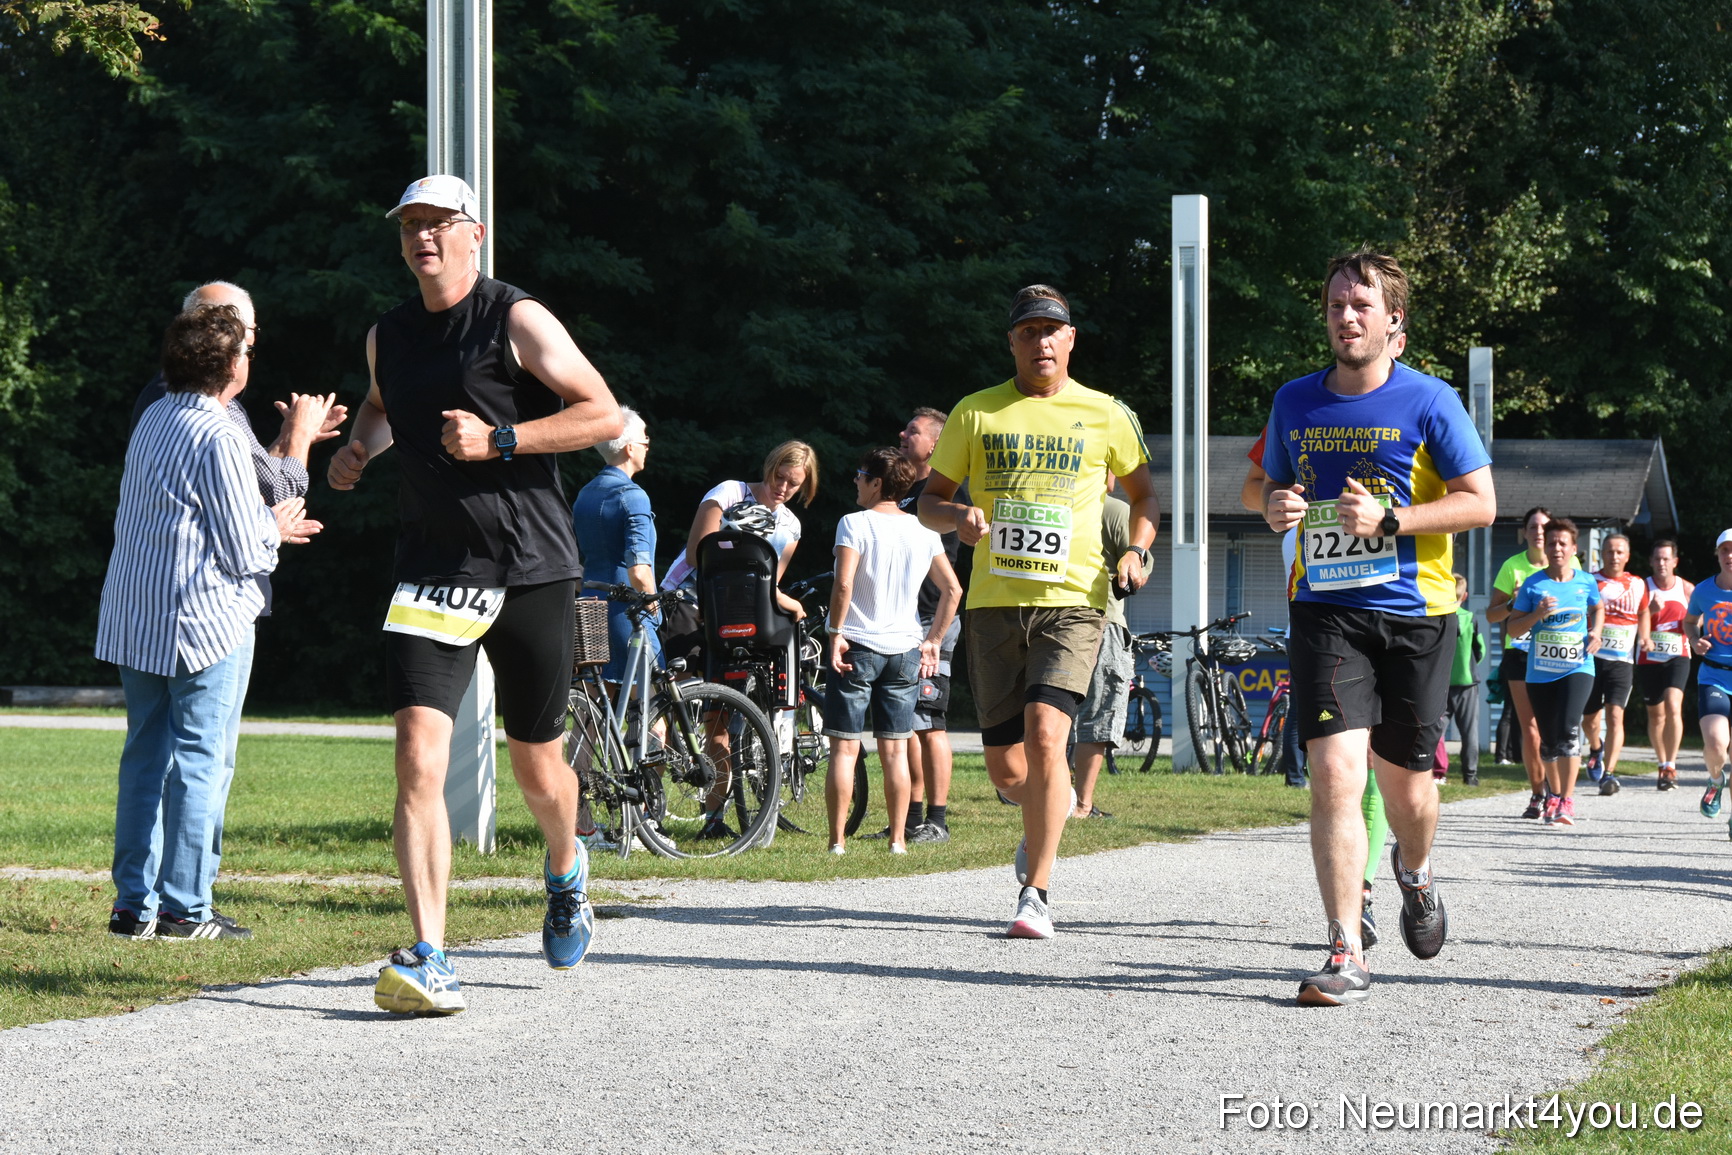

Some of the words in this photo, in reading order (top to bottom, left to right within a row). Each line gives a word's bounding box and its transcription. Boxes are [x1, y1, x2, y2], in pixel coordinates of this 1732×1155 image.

[1290, 429, 1301, 441] 10.
[1304, 427, 1401, 441] NEUMARKTER
[982, 433, 1020, 450] BMW
[1024, 434, 1085, 454] BERLIN
[1300, 439, 1379, 453] STADTLAUF
[986, 451, 1082, 472] MARATHON
[999, 504, 1062, 523] BOCK
[1308, 506, 1338, 523] BO
[998, 527, 1061, 555] 1329
[1312, 531, 1384, 560] 2220
[995, 556, 1059, 572] THORSTEN
[1319, 563, 1379, 580] MANUEL
[412, 584, 488, 616] 1404
[1540, 632, 1577, 642] BOCK
[1601, 638, 1625, 649] 725
[1540, 645, 1578, 660] 2009
